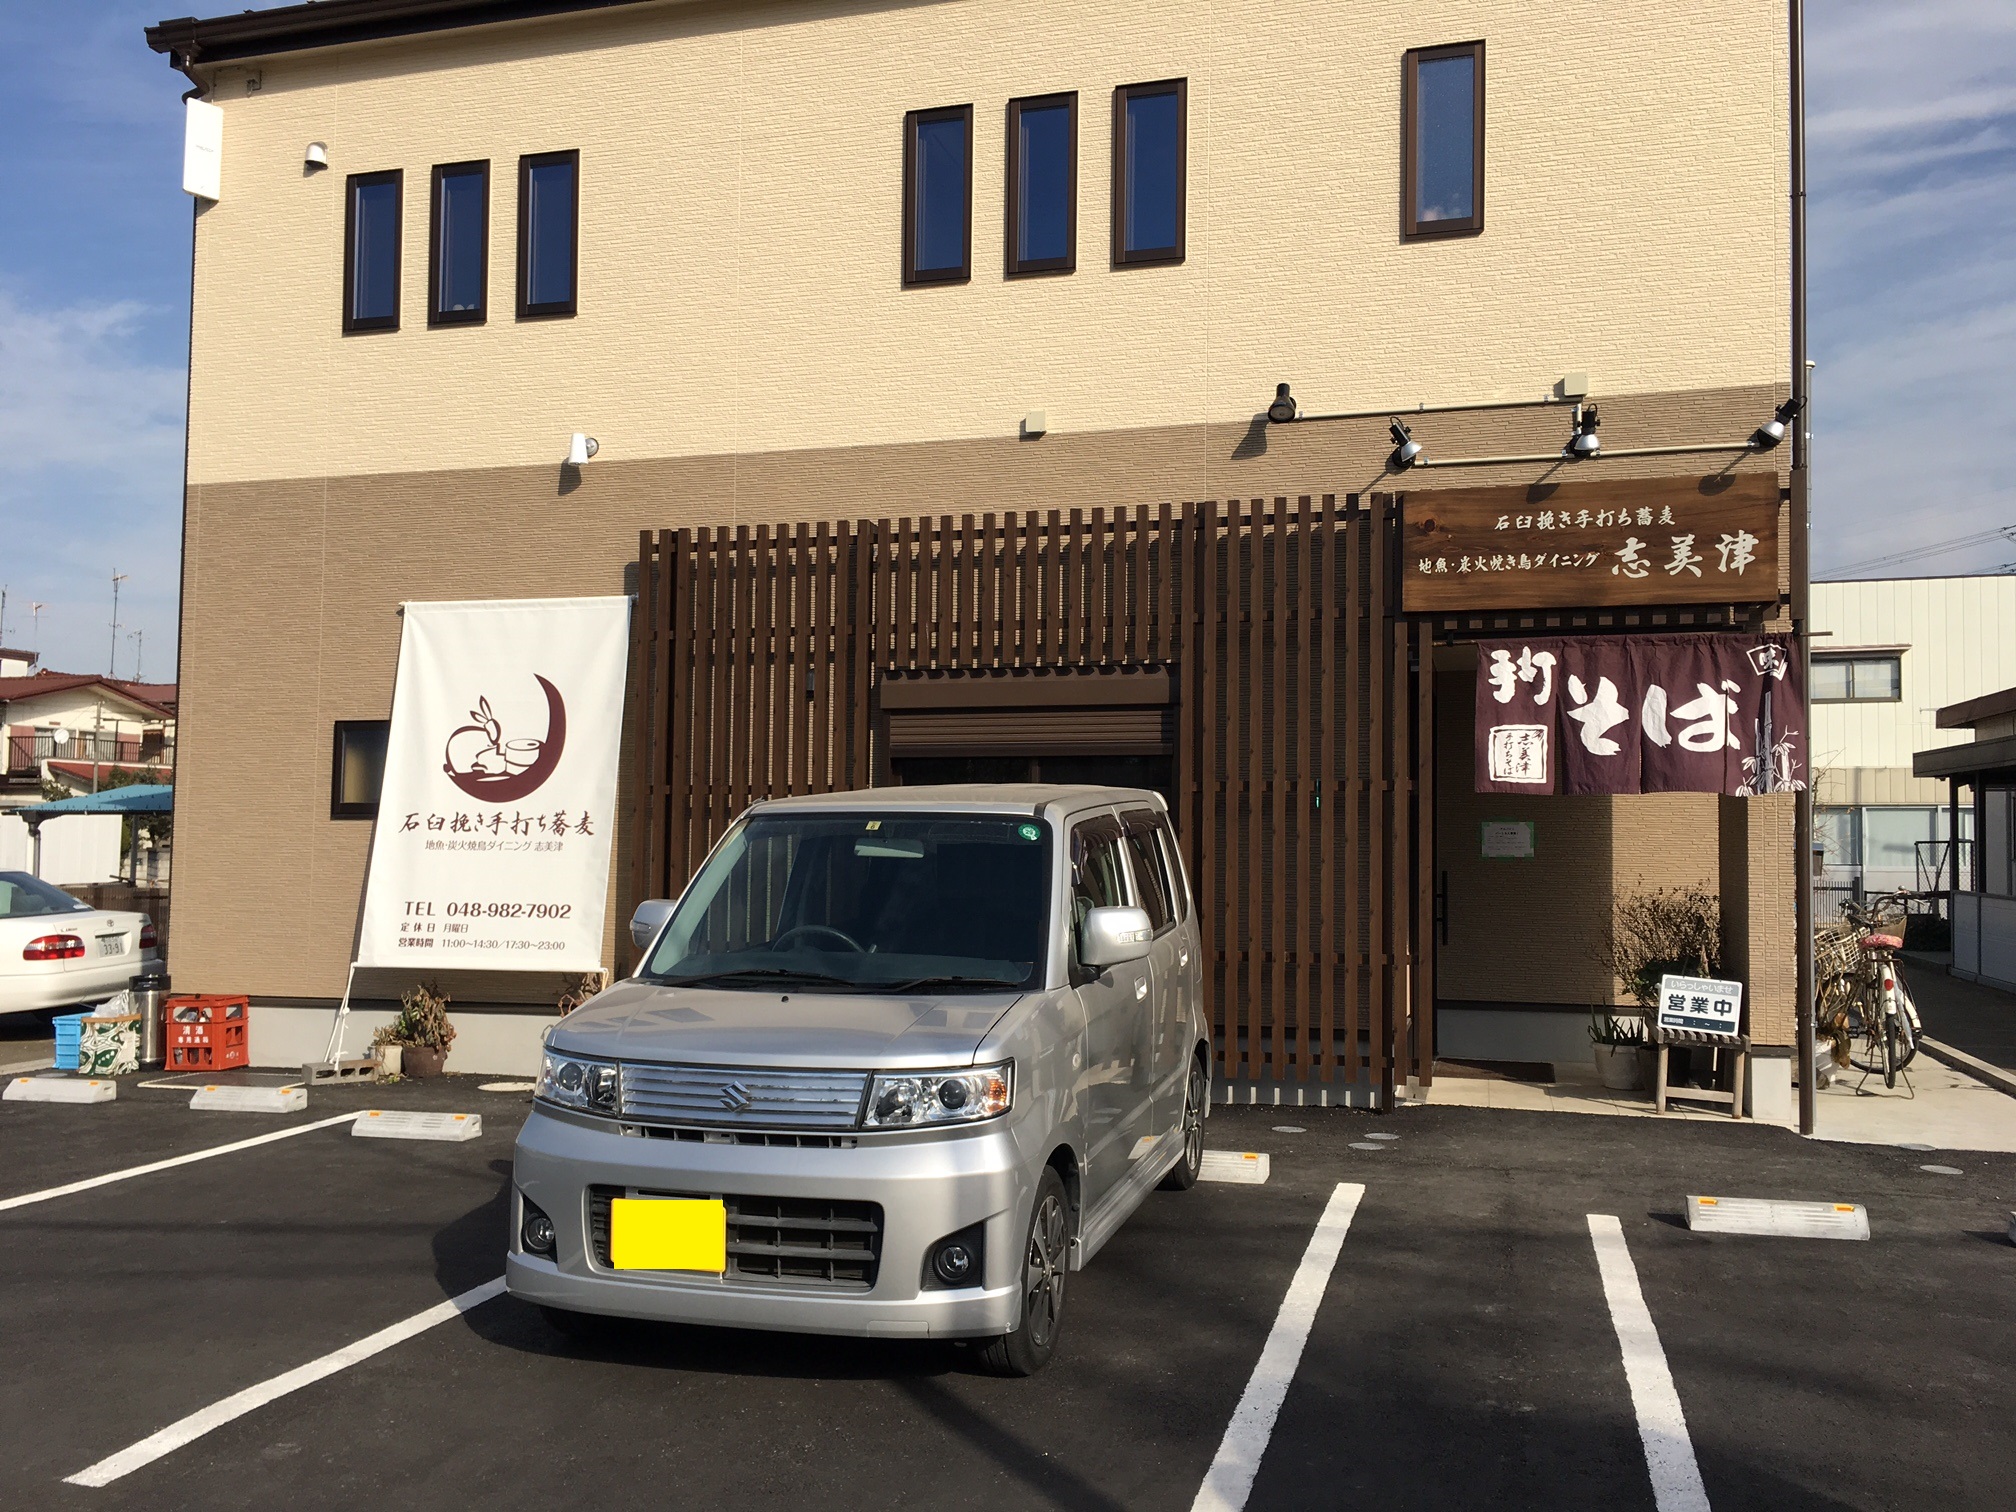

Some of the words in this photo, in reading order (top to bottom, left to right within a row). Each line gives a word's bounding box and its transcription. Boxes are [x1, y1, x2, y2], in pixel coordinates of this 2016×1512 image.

[1494, 505, 1676, 531] 石臼挽き手打ち蕎麦
[1611, 529, 1760, 579] 志美津
[398, 809, 595, 837] 石臼挽き手打ち蕎麦
[534, 840, 564, 852] 志美津
[404, 901, 436, 917] TEL
[446, 901, 572, 919] 048-982-7902
[400, 922, 436, 933] 定休日
[443, 922, 469, 934] 月曜日
[398, 937, 434, 948] 営業時間
[1670, 980, 1733, 994] いらっしゃいませ
[1667, 993, 1733, 1017] 営業中
